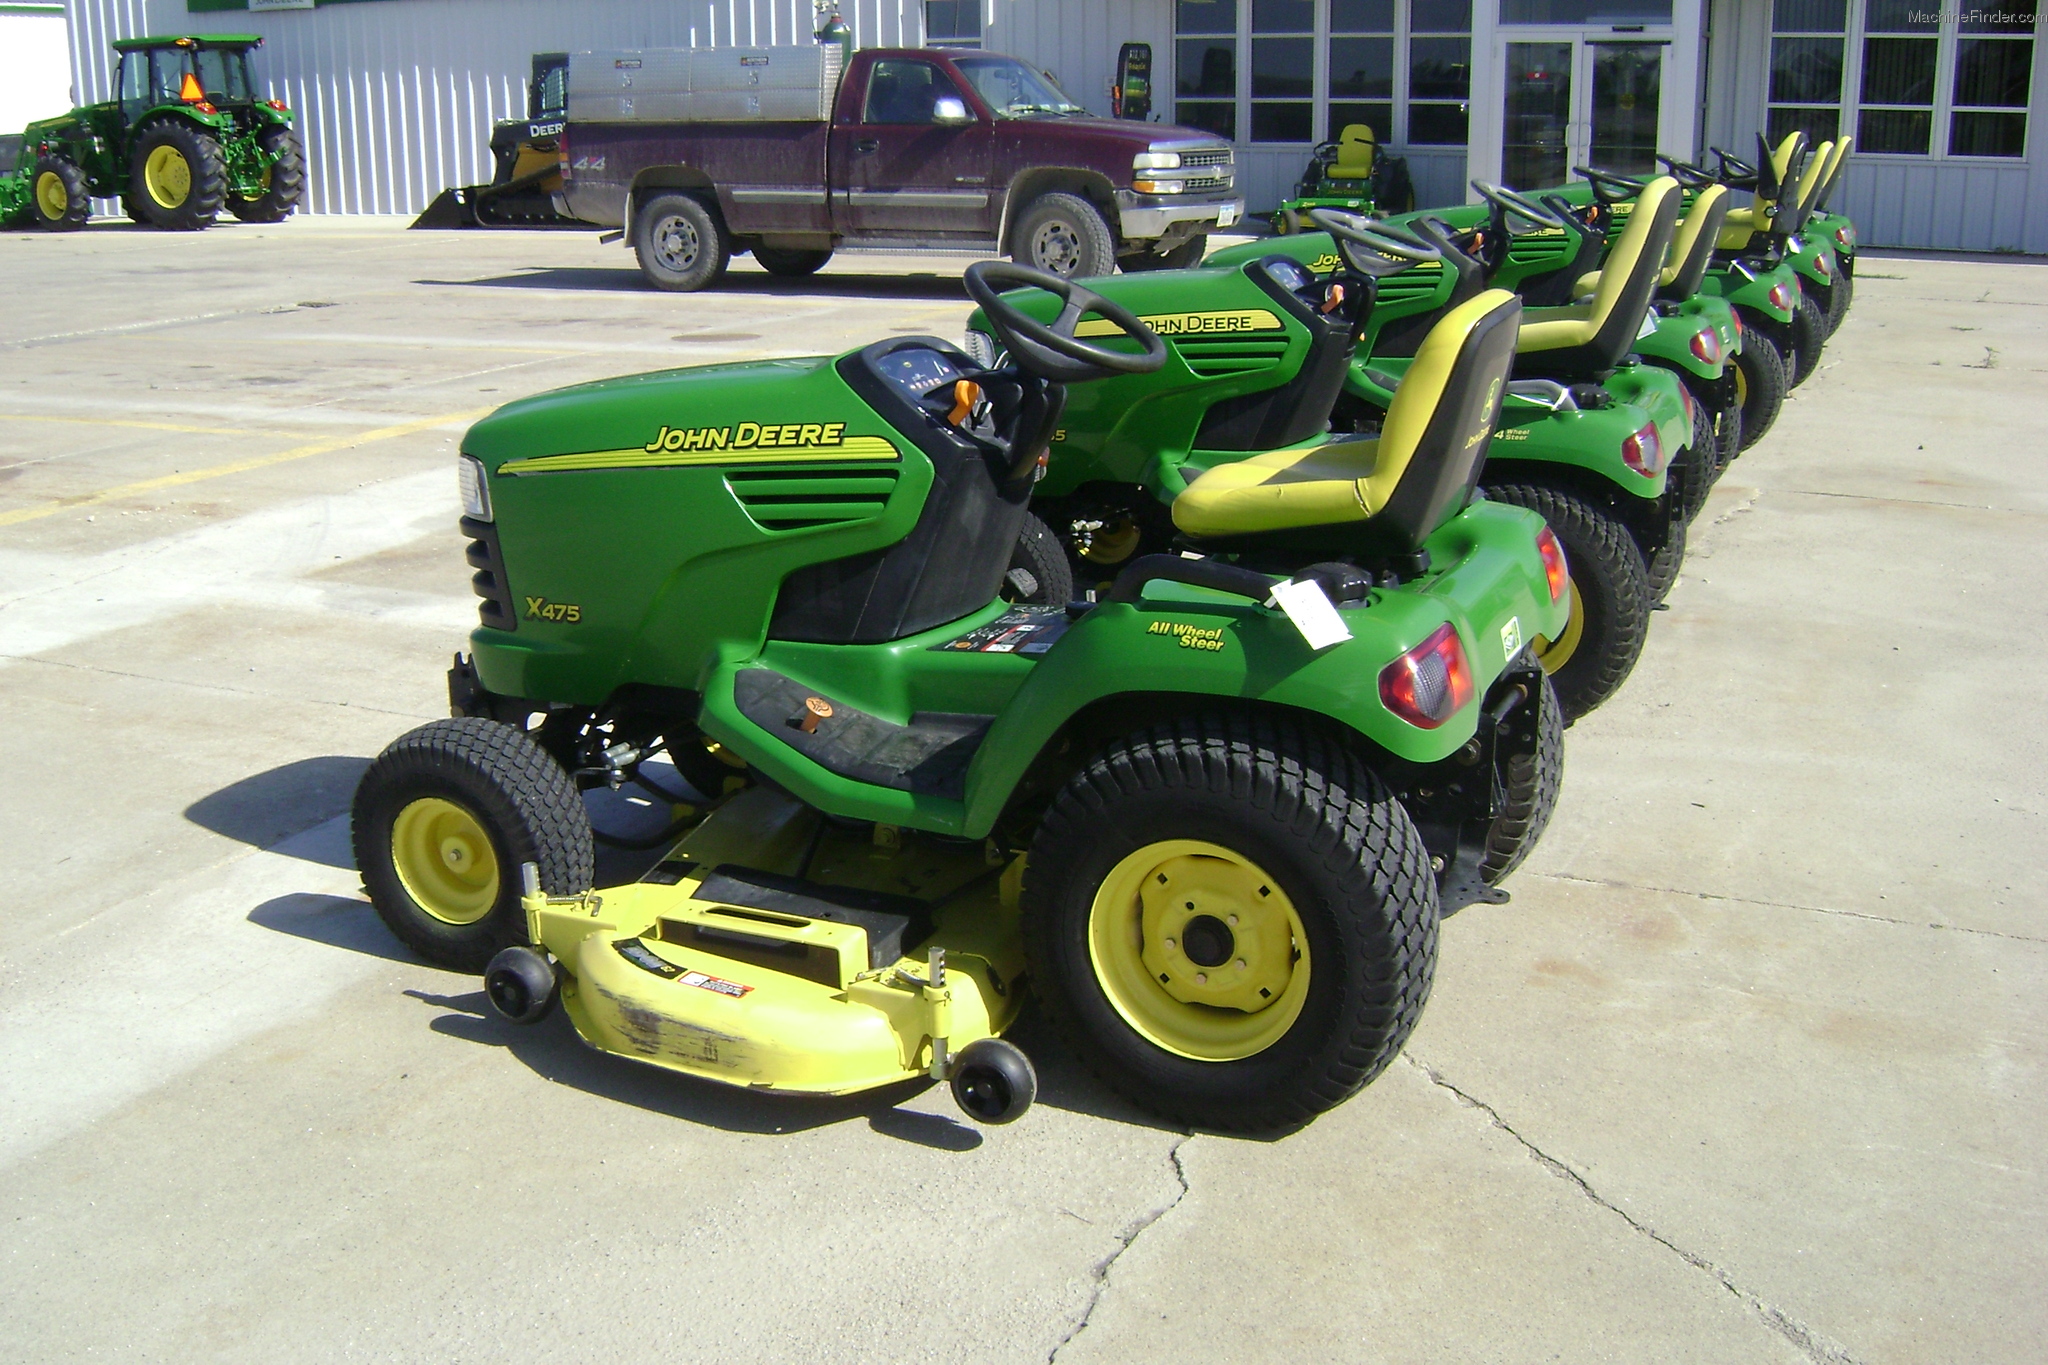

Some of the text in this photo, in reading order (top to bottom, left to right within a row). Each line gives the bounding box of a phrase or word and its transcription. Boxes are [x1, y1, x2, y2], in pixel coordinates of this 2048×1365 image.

[529, 123, 566, 138] DEER
[1313, 253, 1343, 266] JOH
[1187, 316, 1252, 330] DEERE
[646, 422, 845, 451] JOHN DEERE
[524, 596, 581, 622] X475
[1147, 621, 1223, 641] All Wheel
[1179, 635, 1224, 651] Steer
